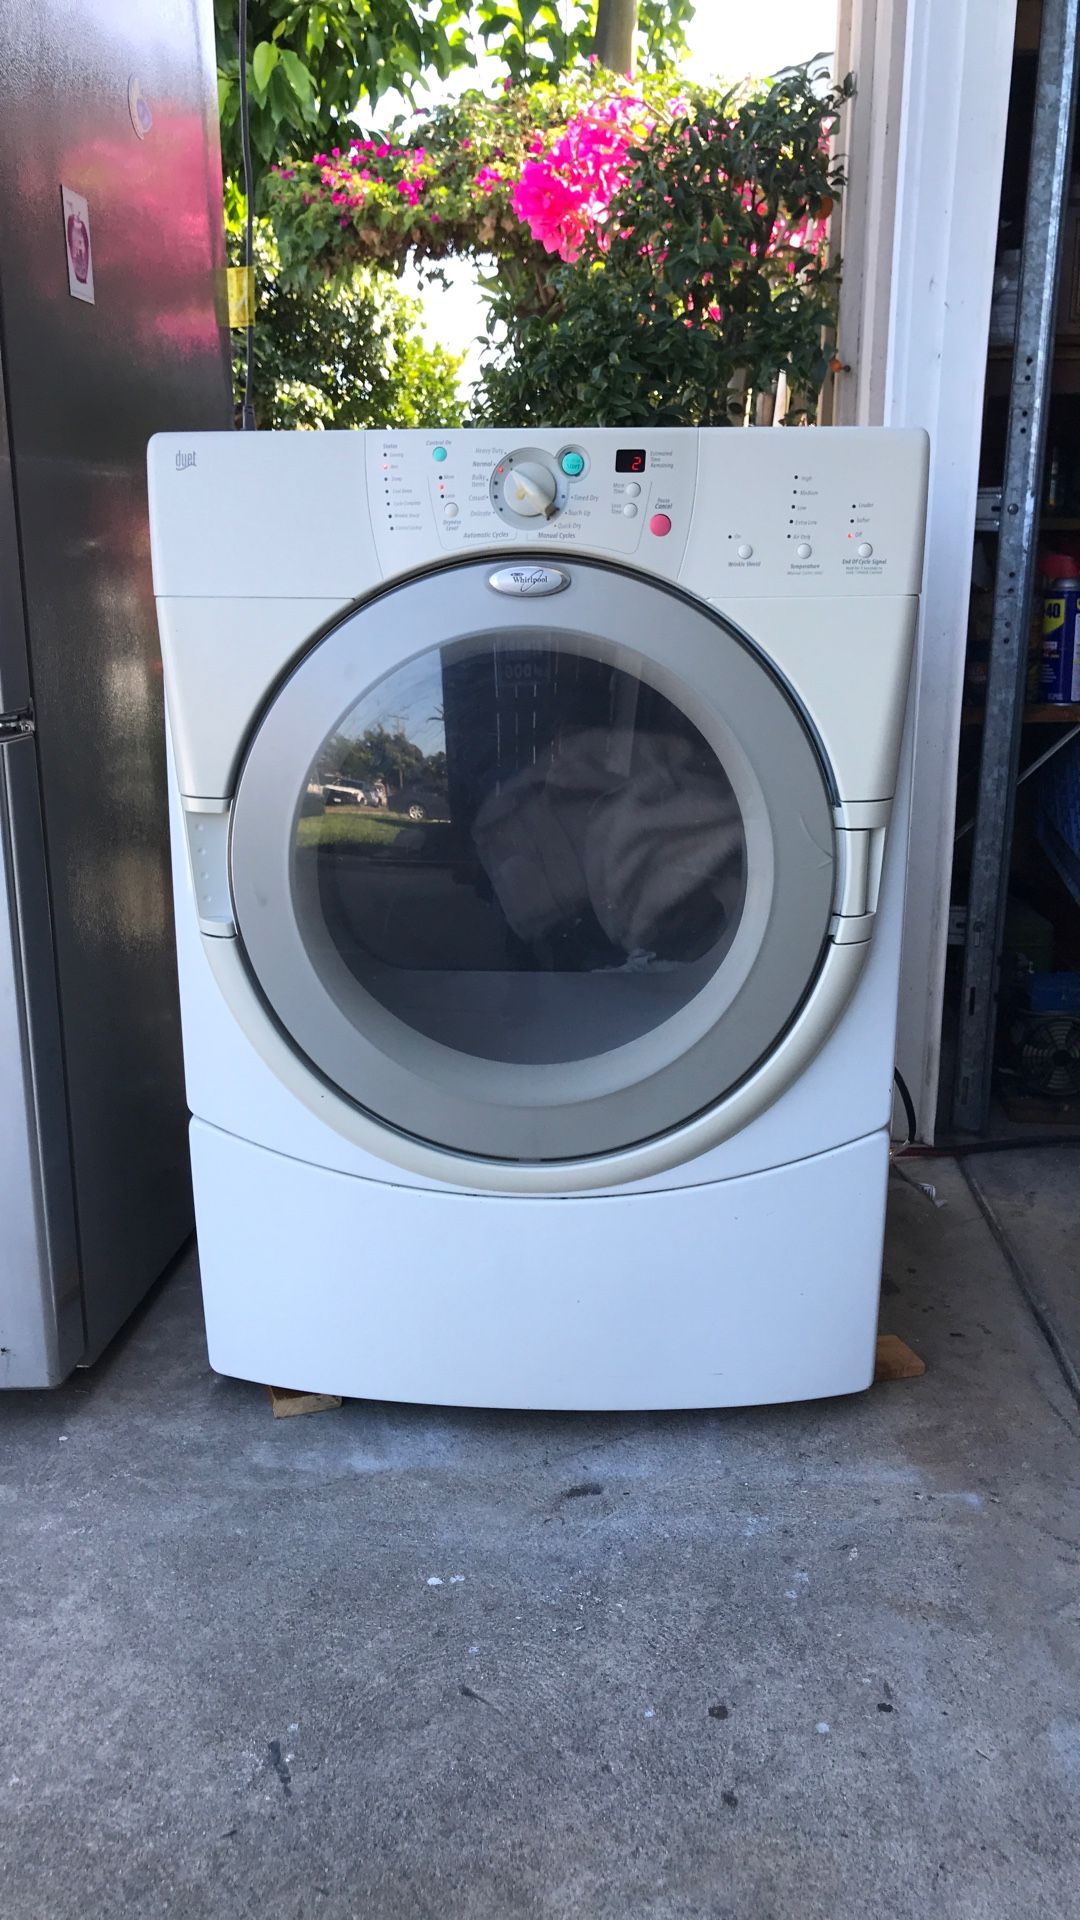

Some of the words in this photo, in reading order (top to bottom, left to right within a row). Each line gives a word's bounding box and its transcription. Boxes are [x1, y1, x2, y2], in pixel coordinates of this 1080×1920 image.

[175, 449, 198, 471] duet
[631, 456, 642, 471] 2
[472, 473, 485, 481] Bulky
[589, 494, 599, 502] Dry
[492, 531, 509, 539] Cycles
[860, 558, 871, 566] Cycle
[872, 558, 887, 566] Signal
[512, 573, 548, 588] Whirlpool
